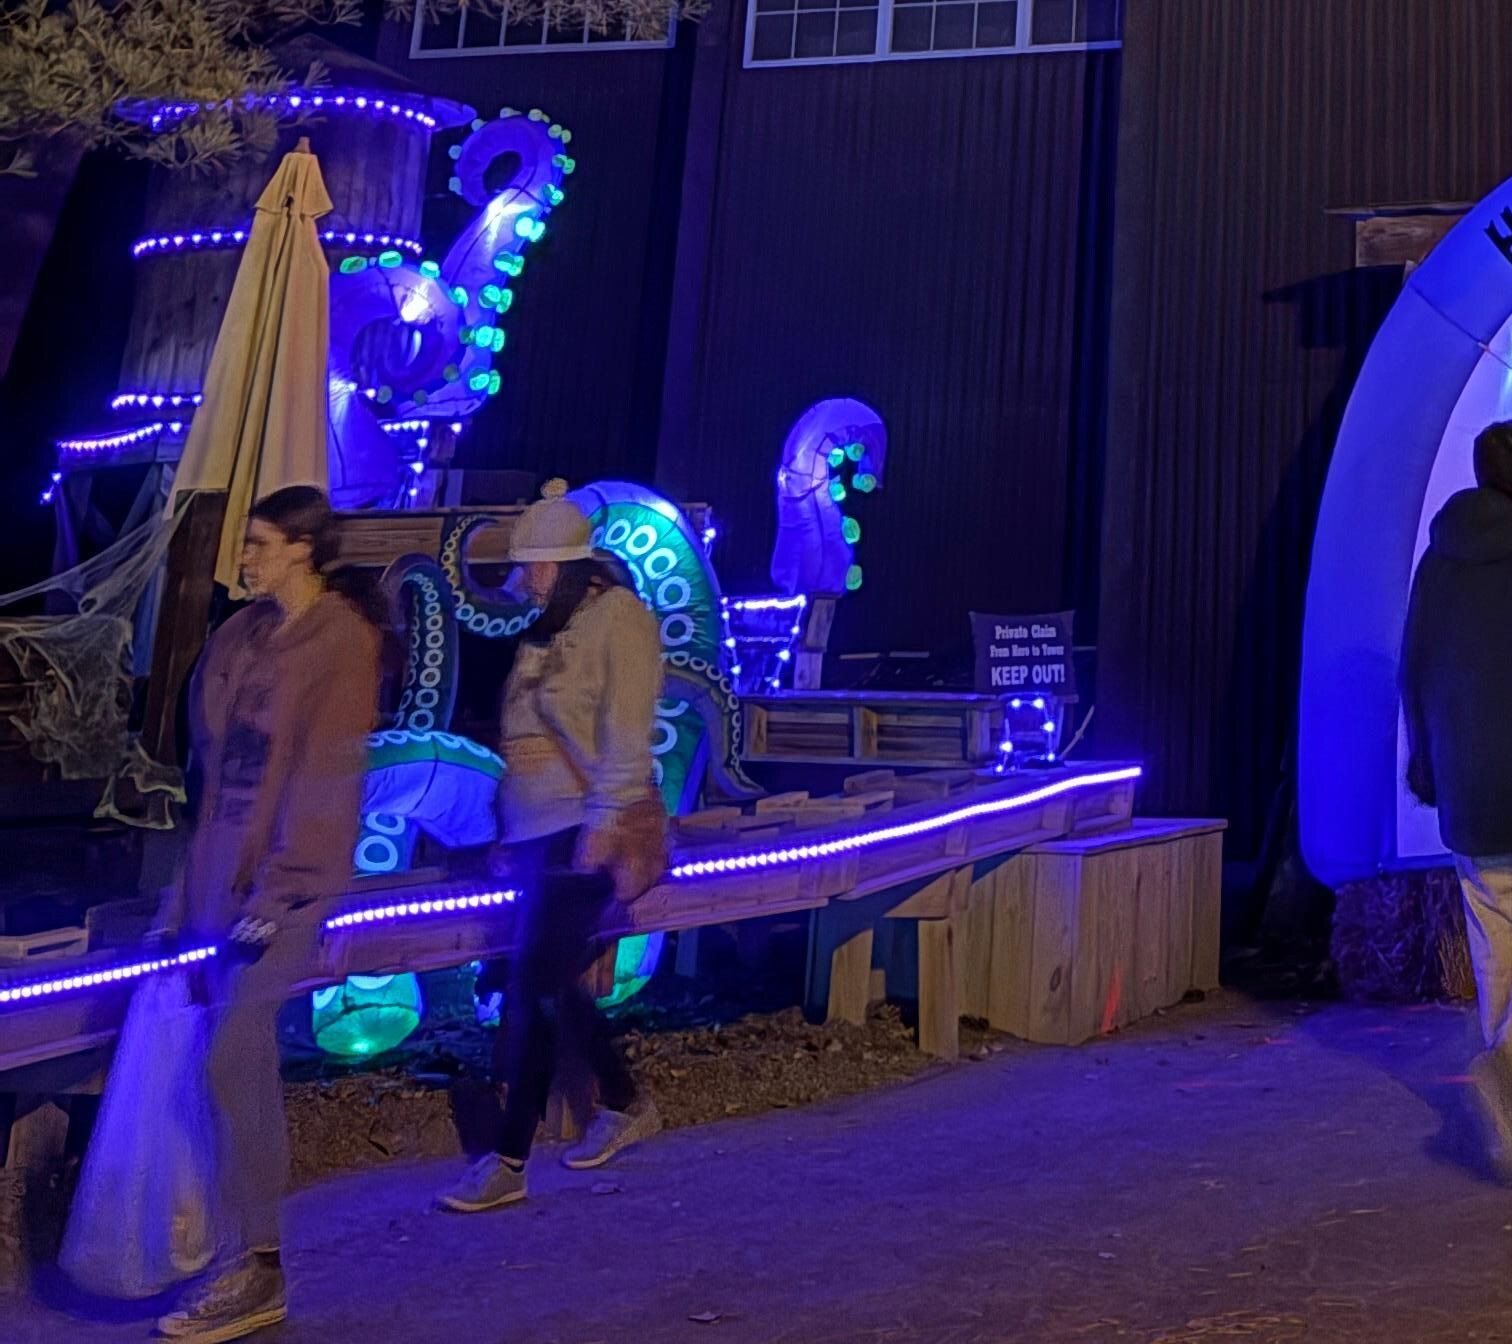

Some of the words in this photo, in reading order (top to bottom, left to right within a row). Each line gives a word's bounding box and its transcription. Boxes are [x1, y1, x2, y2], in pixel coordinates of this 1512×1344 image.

[995, 625, 1028, 640] Private
[1031, 624, 1057, 638] Claim
[990, 645, 1010, 658] From
[991, 666, 1028, 686] KEEP
[1032, 664, 1065, 683] OUT!
